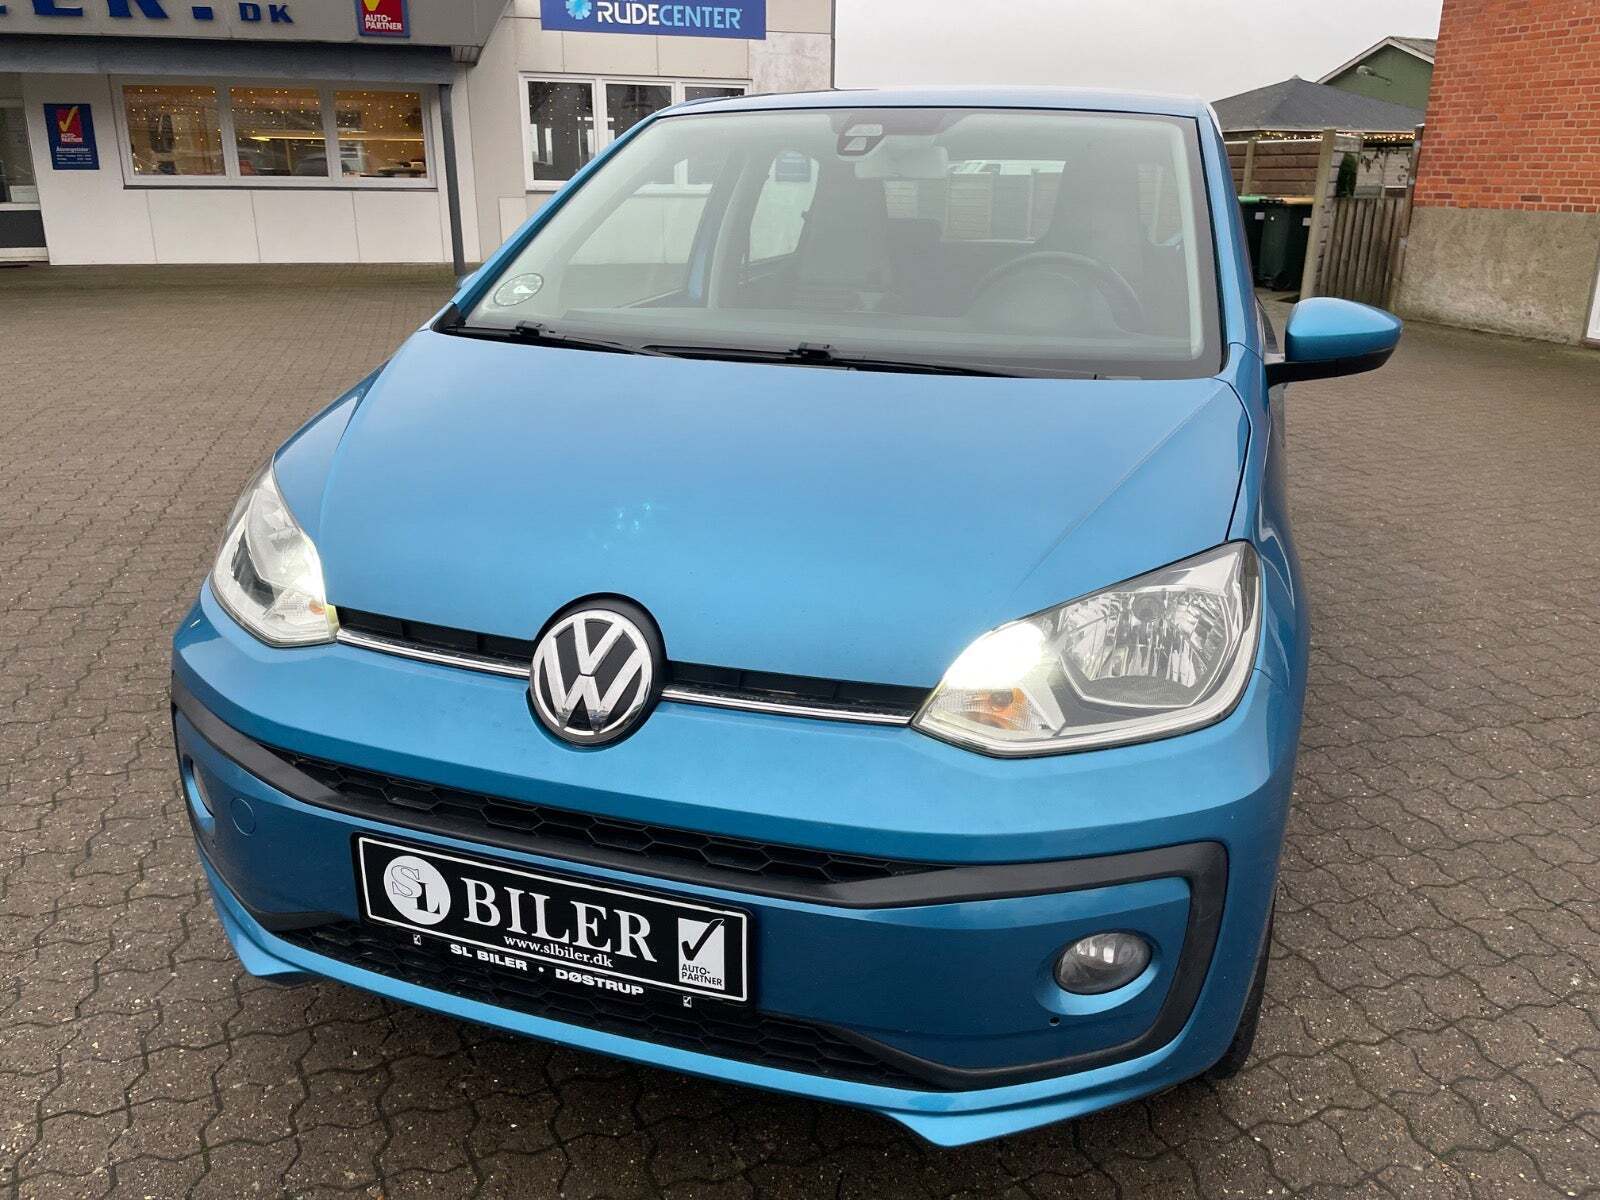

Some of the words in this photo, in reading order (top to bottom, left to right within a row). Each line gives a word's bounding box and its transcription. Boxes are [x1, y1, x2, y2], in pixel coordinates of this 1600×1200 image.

[365, 14, 392, 22] AUTO-
[365, 21, 402, 30] PARTNER
[597, 2, 742, 29] RUDECENTER
[460, 877, 658, 962] BILER
[503, 935, 614, 968] www.slbiler.dk
[450, 943, 473, 958] SL
[476, 950, 528, 971] BILER
[555, 968, 645, 996] DØSTRUP
[682, 963, 711, 975] AUTO-
[682, 971, 722, 987] PARTNER
